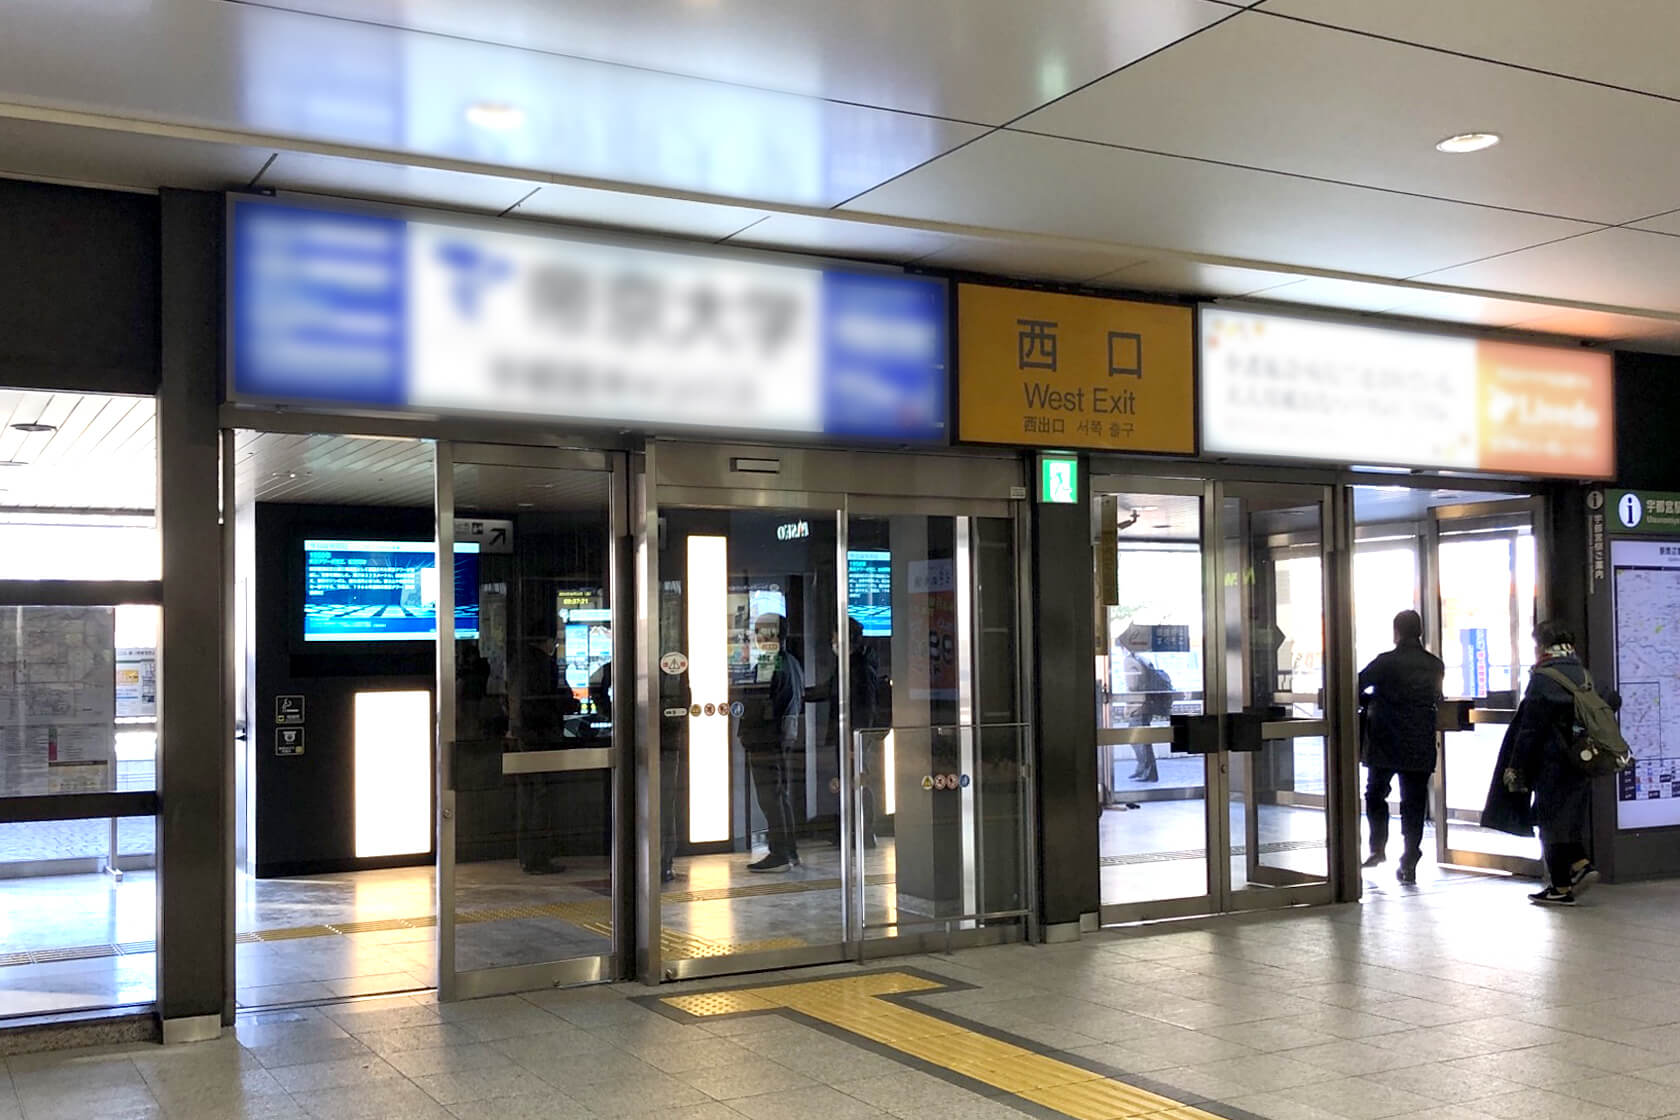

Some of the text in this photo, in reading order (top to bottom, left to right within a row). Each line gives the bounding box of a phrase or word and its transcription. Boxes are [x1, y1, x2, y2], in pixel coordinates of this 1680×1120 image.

[1017, 319, 1142, 379] 西口
[1024, 382, 1136, 415] West Exit
[1024, 416, 1065, 434] 西出口
